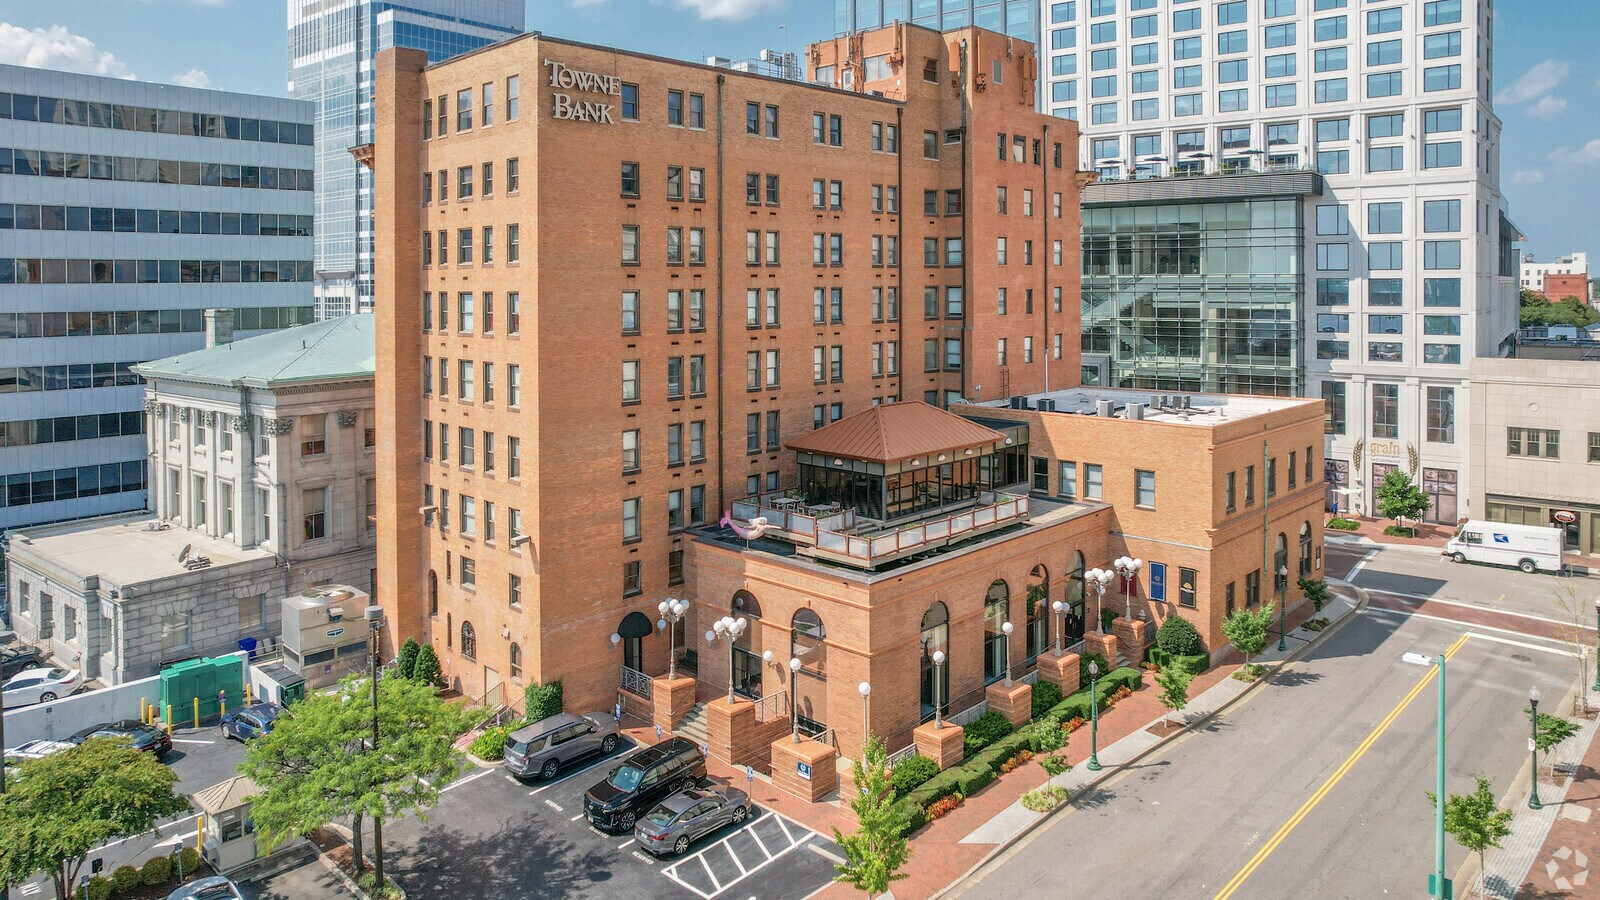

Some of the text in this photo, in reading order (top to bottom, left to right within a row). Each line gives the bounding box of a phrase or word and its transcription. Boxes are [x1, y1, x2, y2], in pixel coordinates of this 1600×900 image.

[544, 58, 621, 97] TOWNE
[552, 92, 615, 125] BANK
[1370, 441, 1400, 457] grain
